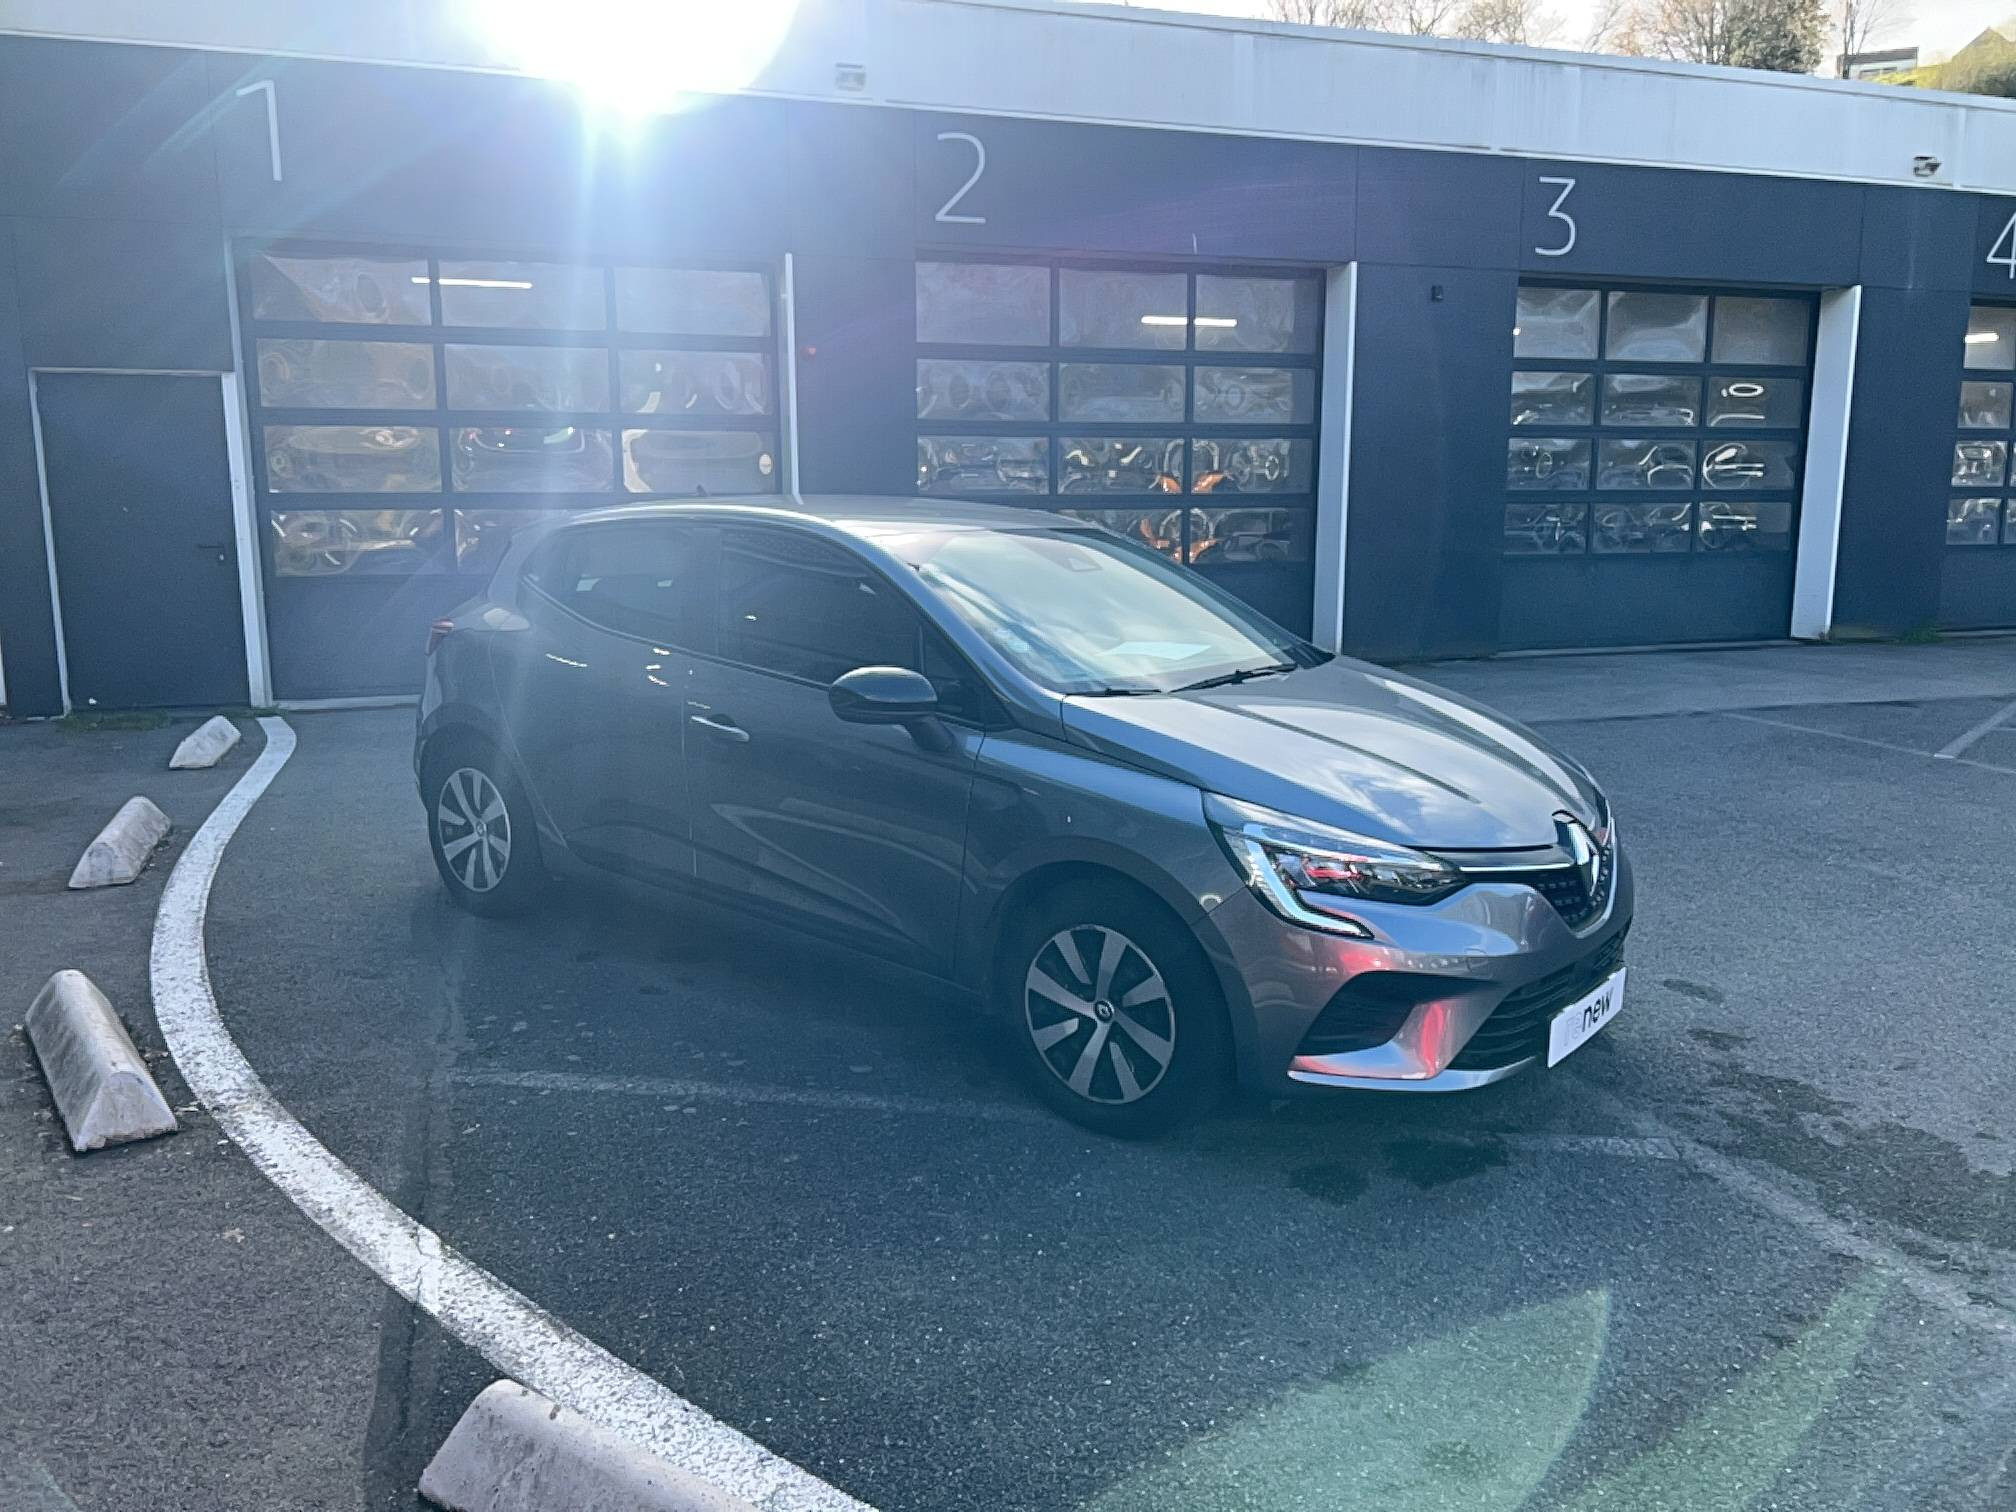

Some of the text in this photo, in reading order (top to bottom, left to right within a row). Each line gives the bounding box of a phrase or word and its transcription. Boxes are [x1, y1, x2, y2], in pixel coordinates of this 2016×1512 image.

[237, 80, 282, 181] 1
[935, 132, 986, 224] 2
[1535, 177, 1576, 256] 3
[1986, 211, 2016, 279] 4
